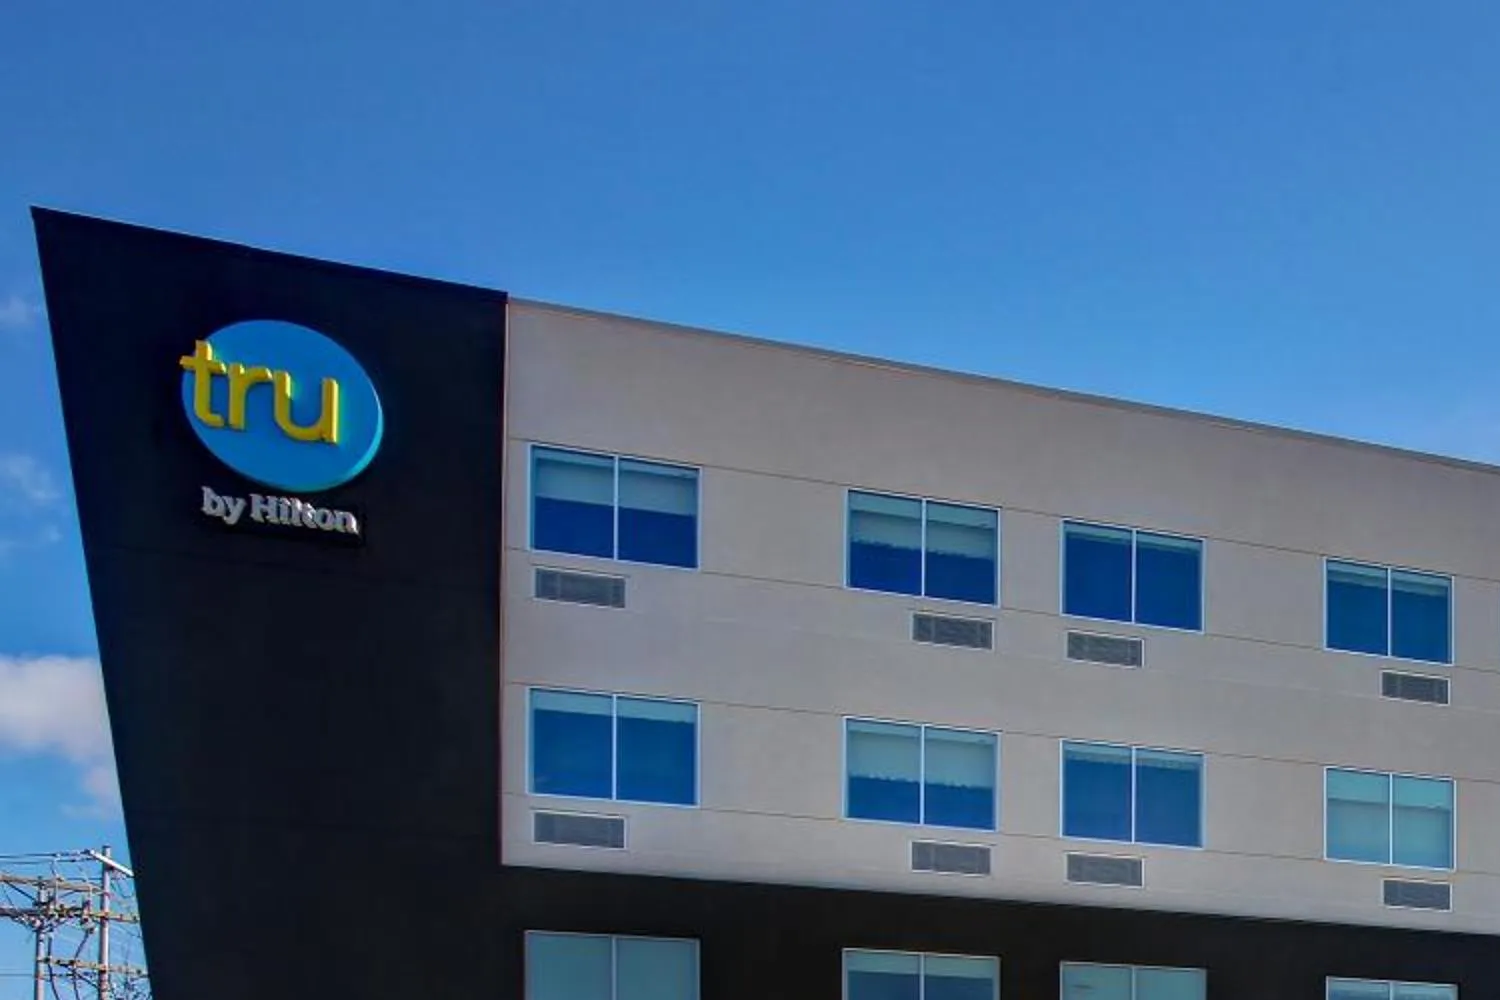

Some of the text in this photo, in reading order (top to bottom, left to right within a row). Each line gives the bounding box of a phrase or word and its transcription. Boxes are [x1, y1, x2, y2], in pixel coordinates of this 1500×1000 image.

[179, 339, 339, 446] tru
[201, 486, 361, 536] by Hilton
